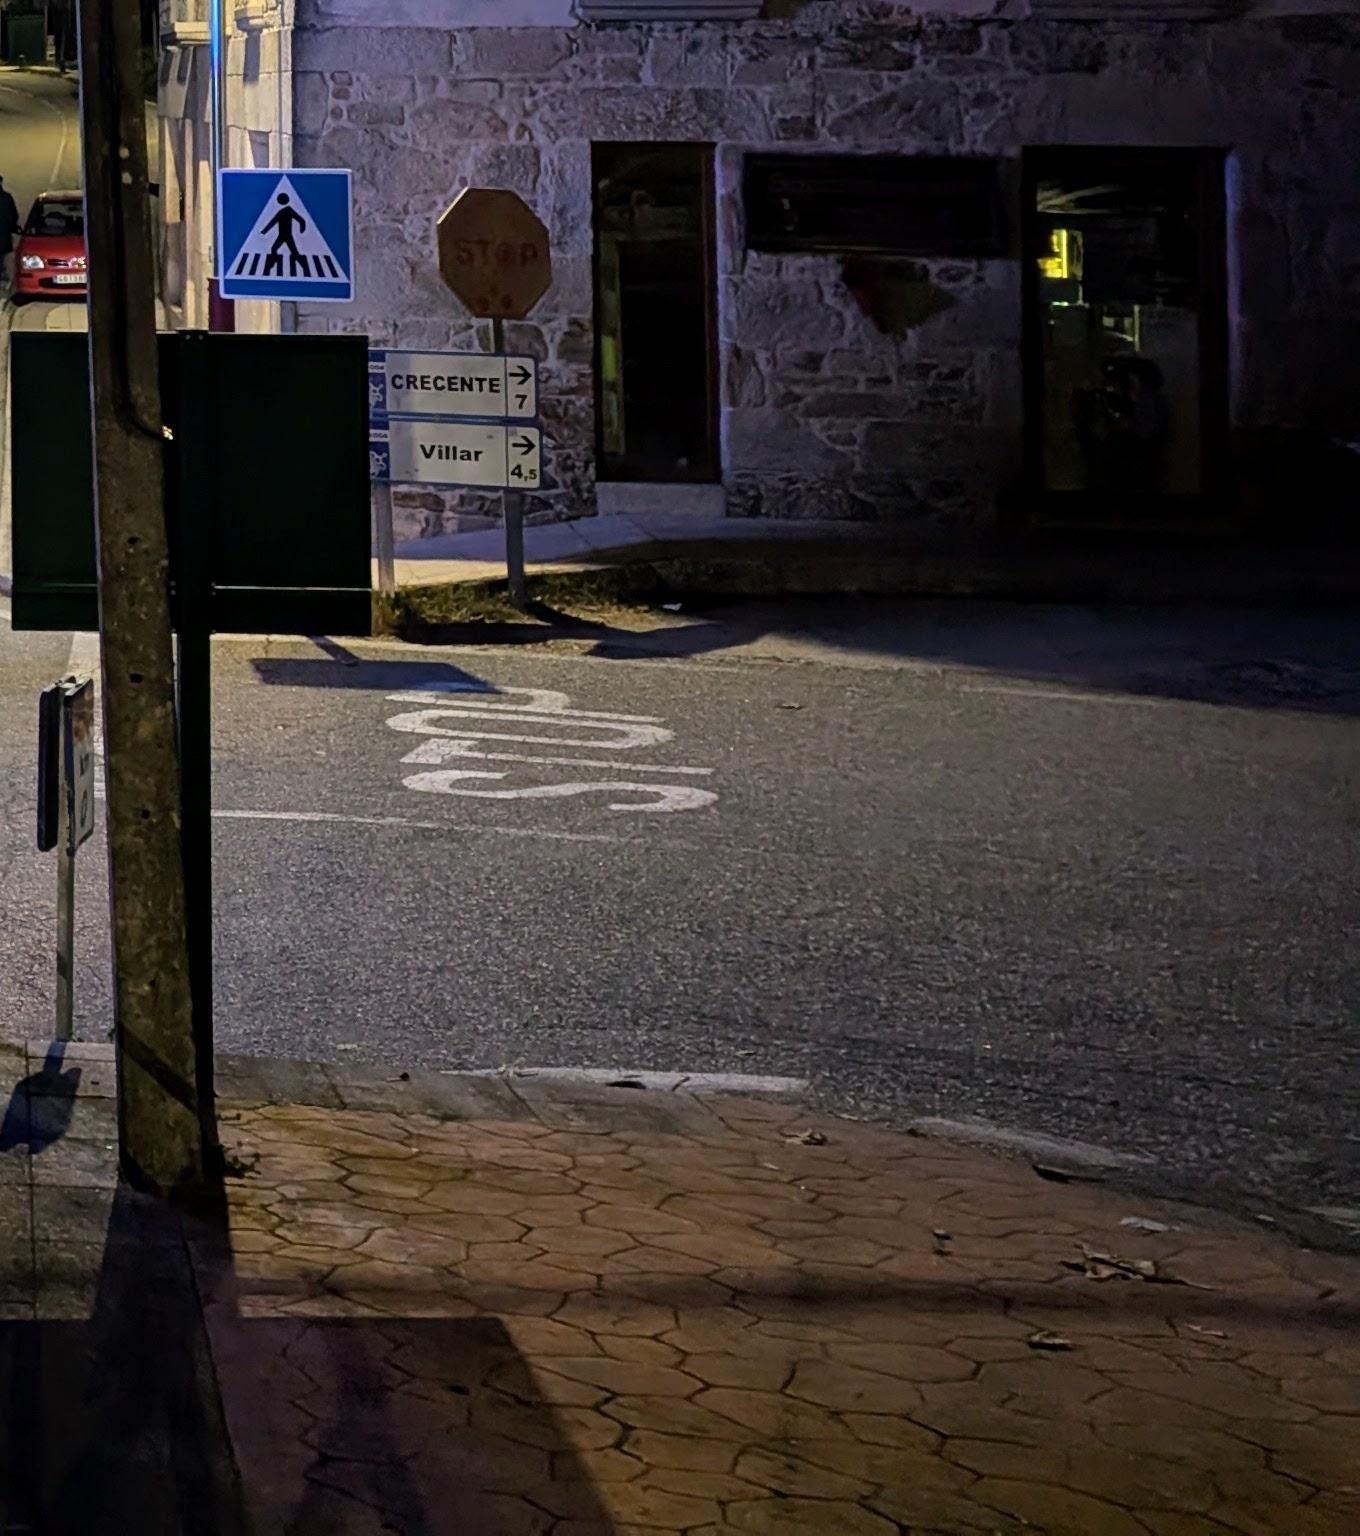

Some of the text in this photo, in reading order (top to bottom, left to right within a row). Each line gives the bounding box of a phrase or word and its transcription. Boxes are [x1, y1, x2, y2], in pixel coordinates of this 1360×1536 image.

[454, 239, 539, 268] STOP
[391, 374, 501, 394] CRECENTE
[515, 395, 528, 411] 7
[420, 443, 483, 463] Villar
[510, 463, 538, 482] 4,5
